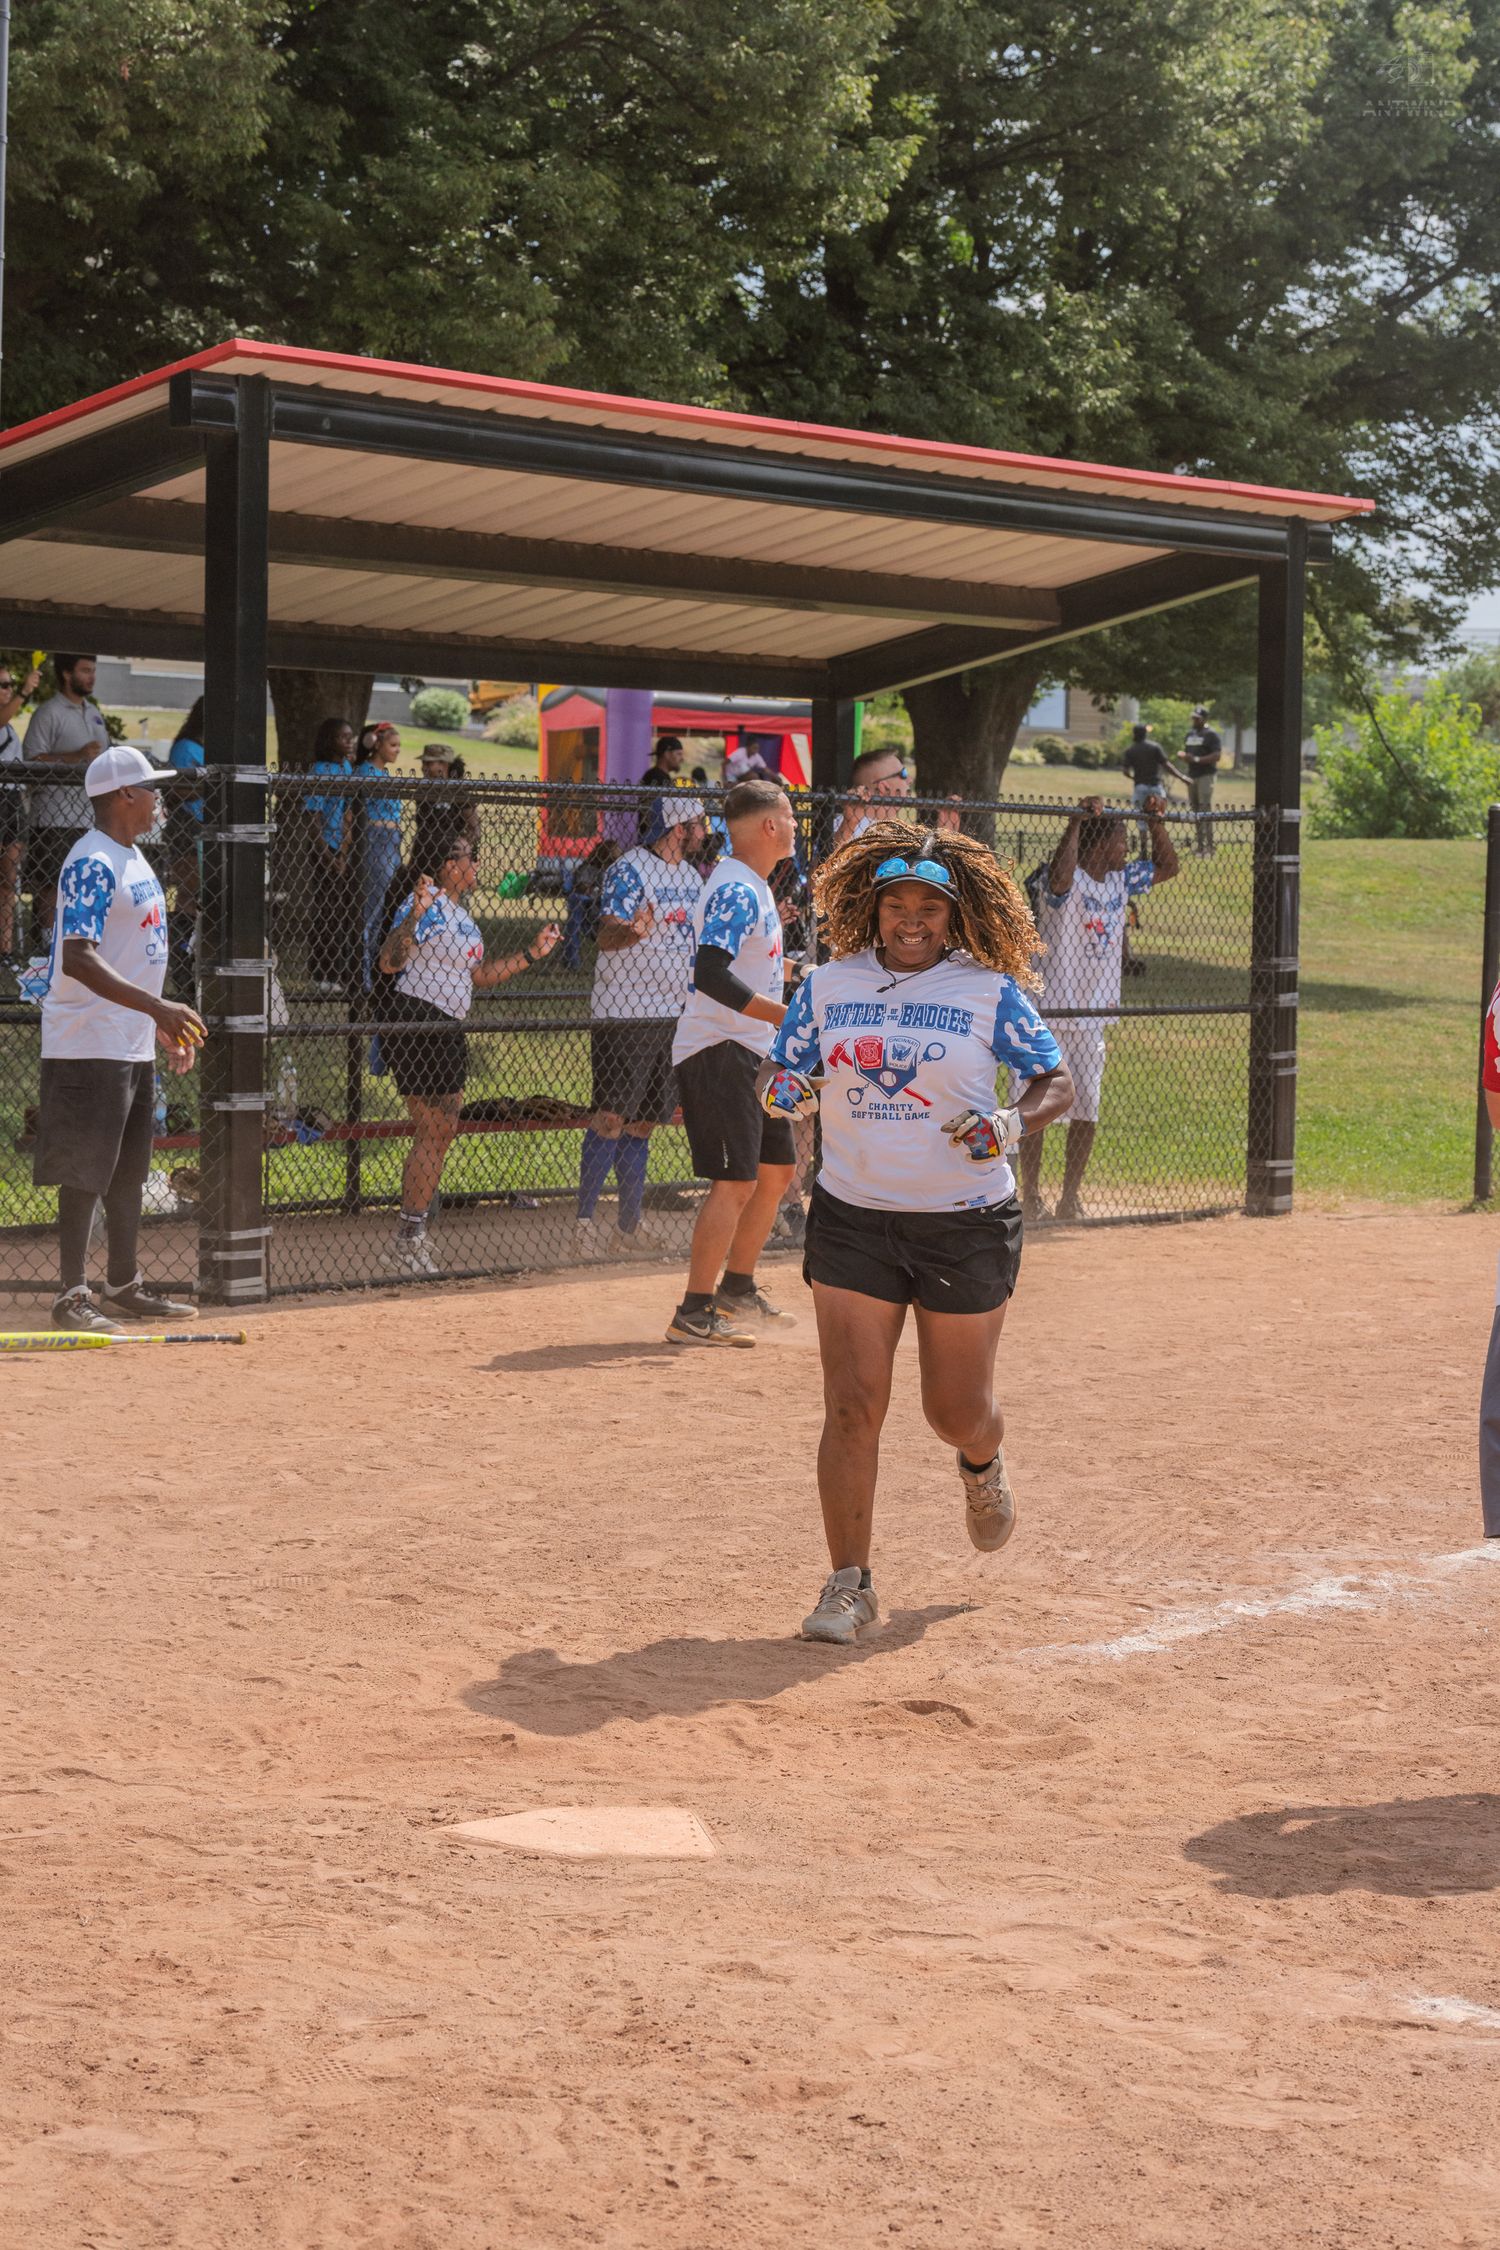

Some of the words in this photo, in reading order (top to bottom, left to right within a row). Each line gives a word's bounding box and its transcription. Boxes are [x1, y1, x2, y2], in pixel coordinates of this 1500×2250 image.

[824, 1003, 886, 1030] BATTLE
[898, 1003, 974, 1037] BADGES
[889, 1038, 918, 1048] CINCINNATI
[869, 1102, 913, 1111] CHARITY
[851, 1111, 902, 1121] SOFTBALL
[904, 1112, 930, 1121] GAME
